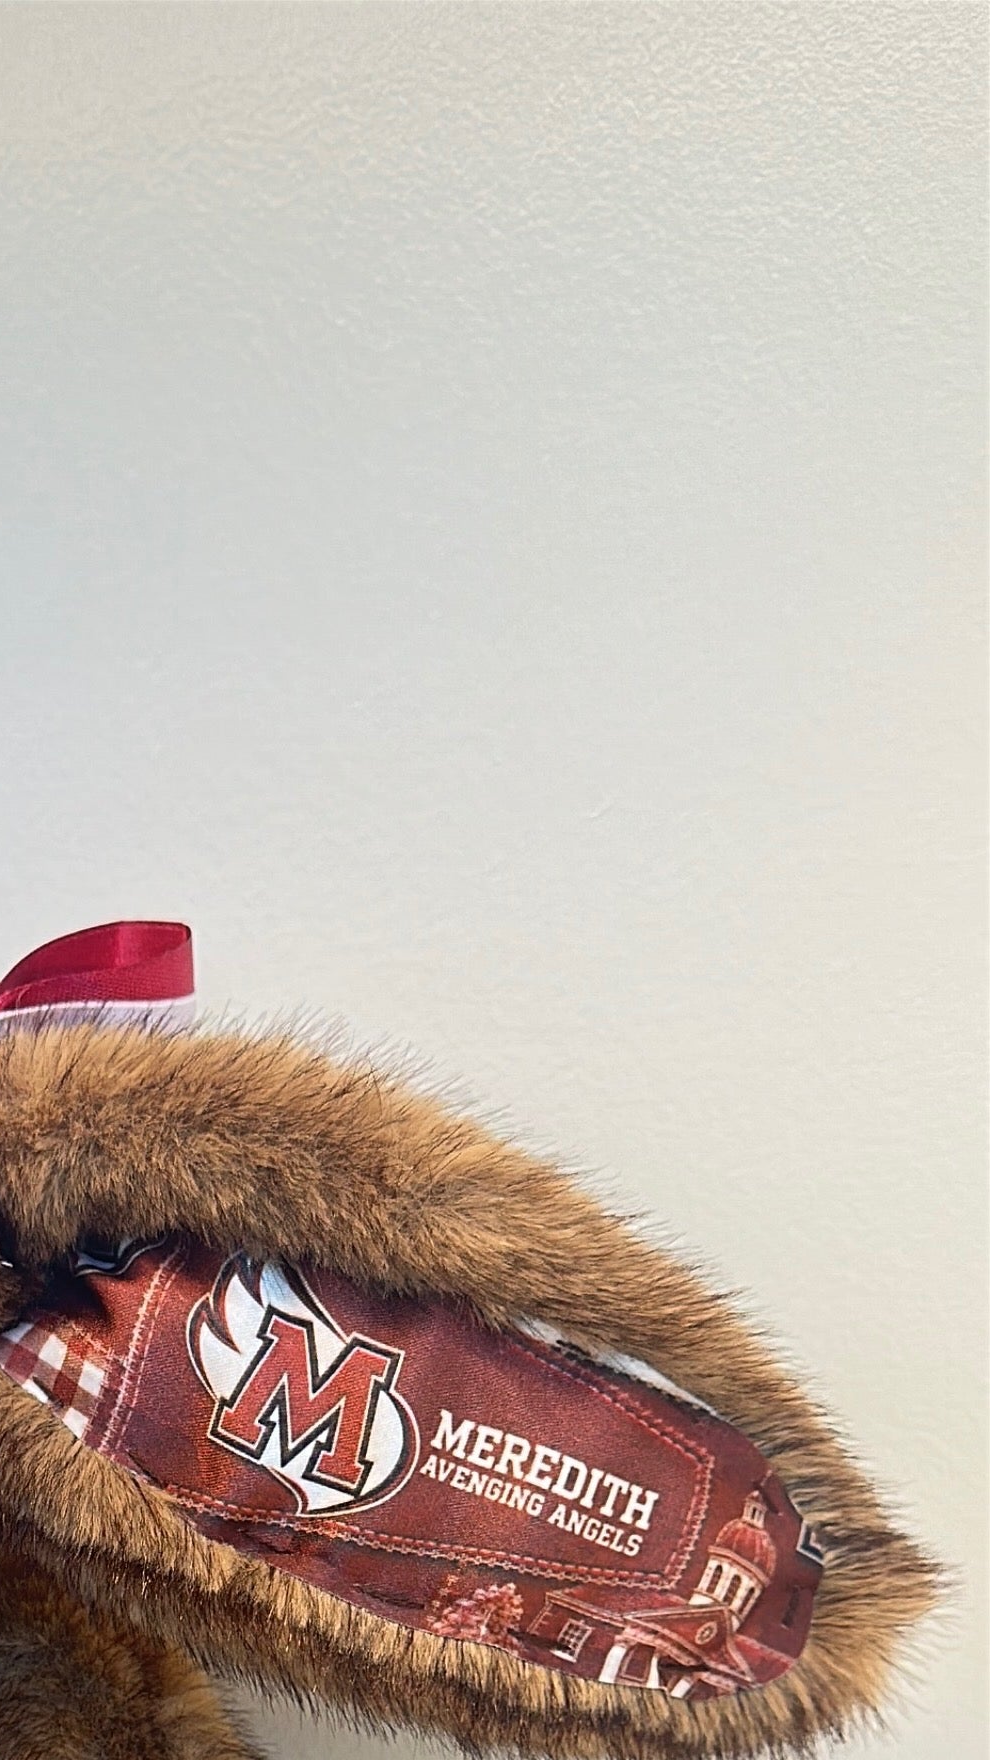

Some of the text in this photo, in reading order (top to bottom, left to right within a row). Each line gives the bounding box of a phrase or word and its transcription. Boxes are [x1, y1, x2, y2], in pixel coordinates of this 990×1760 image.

[419, 1454, 644, 1557] AVENGING ANGELS
[430, 1409, 659, 1531] MEREDITH
